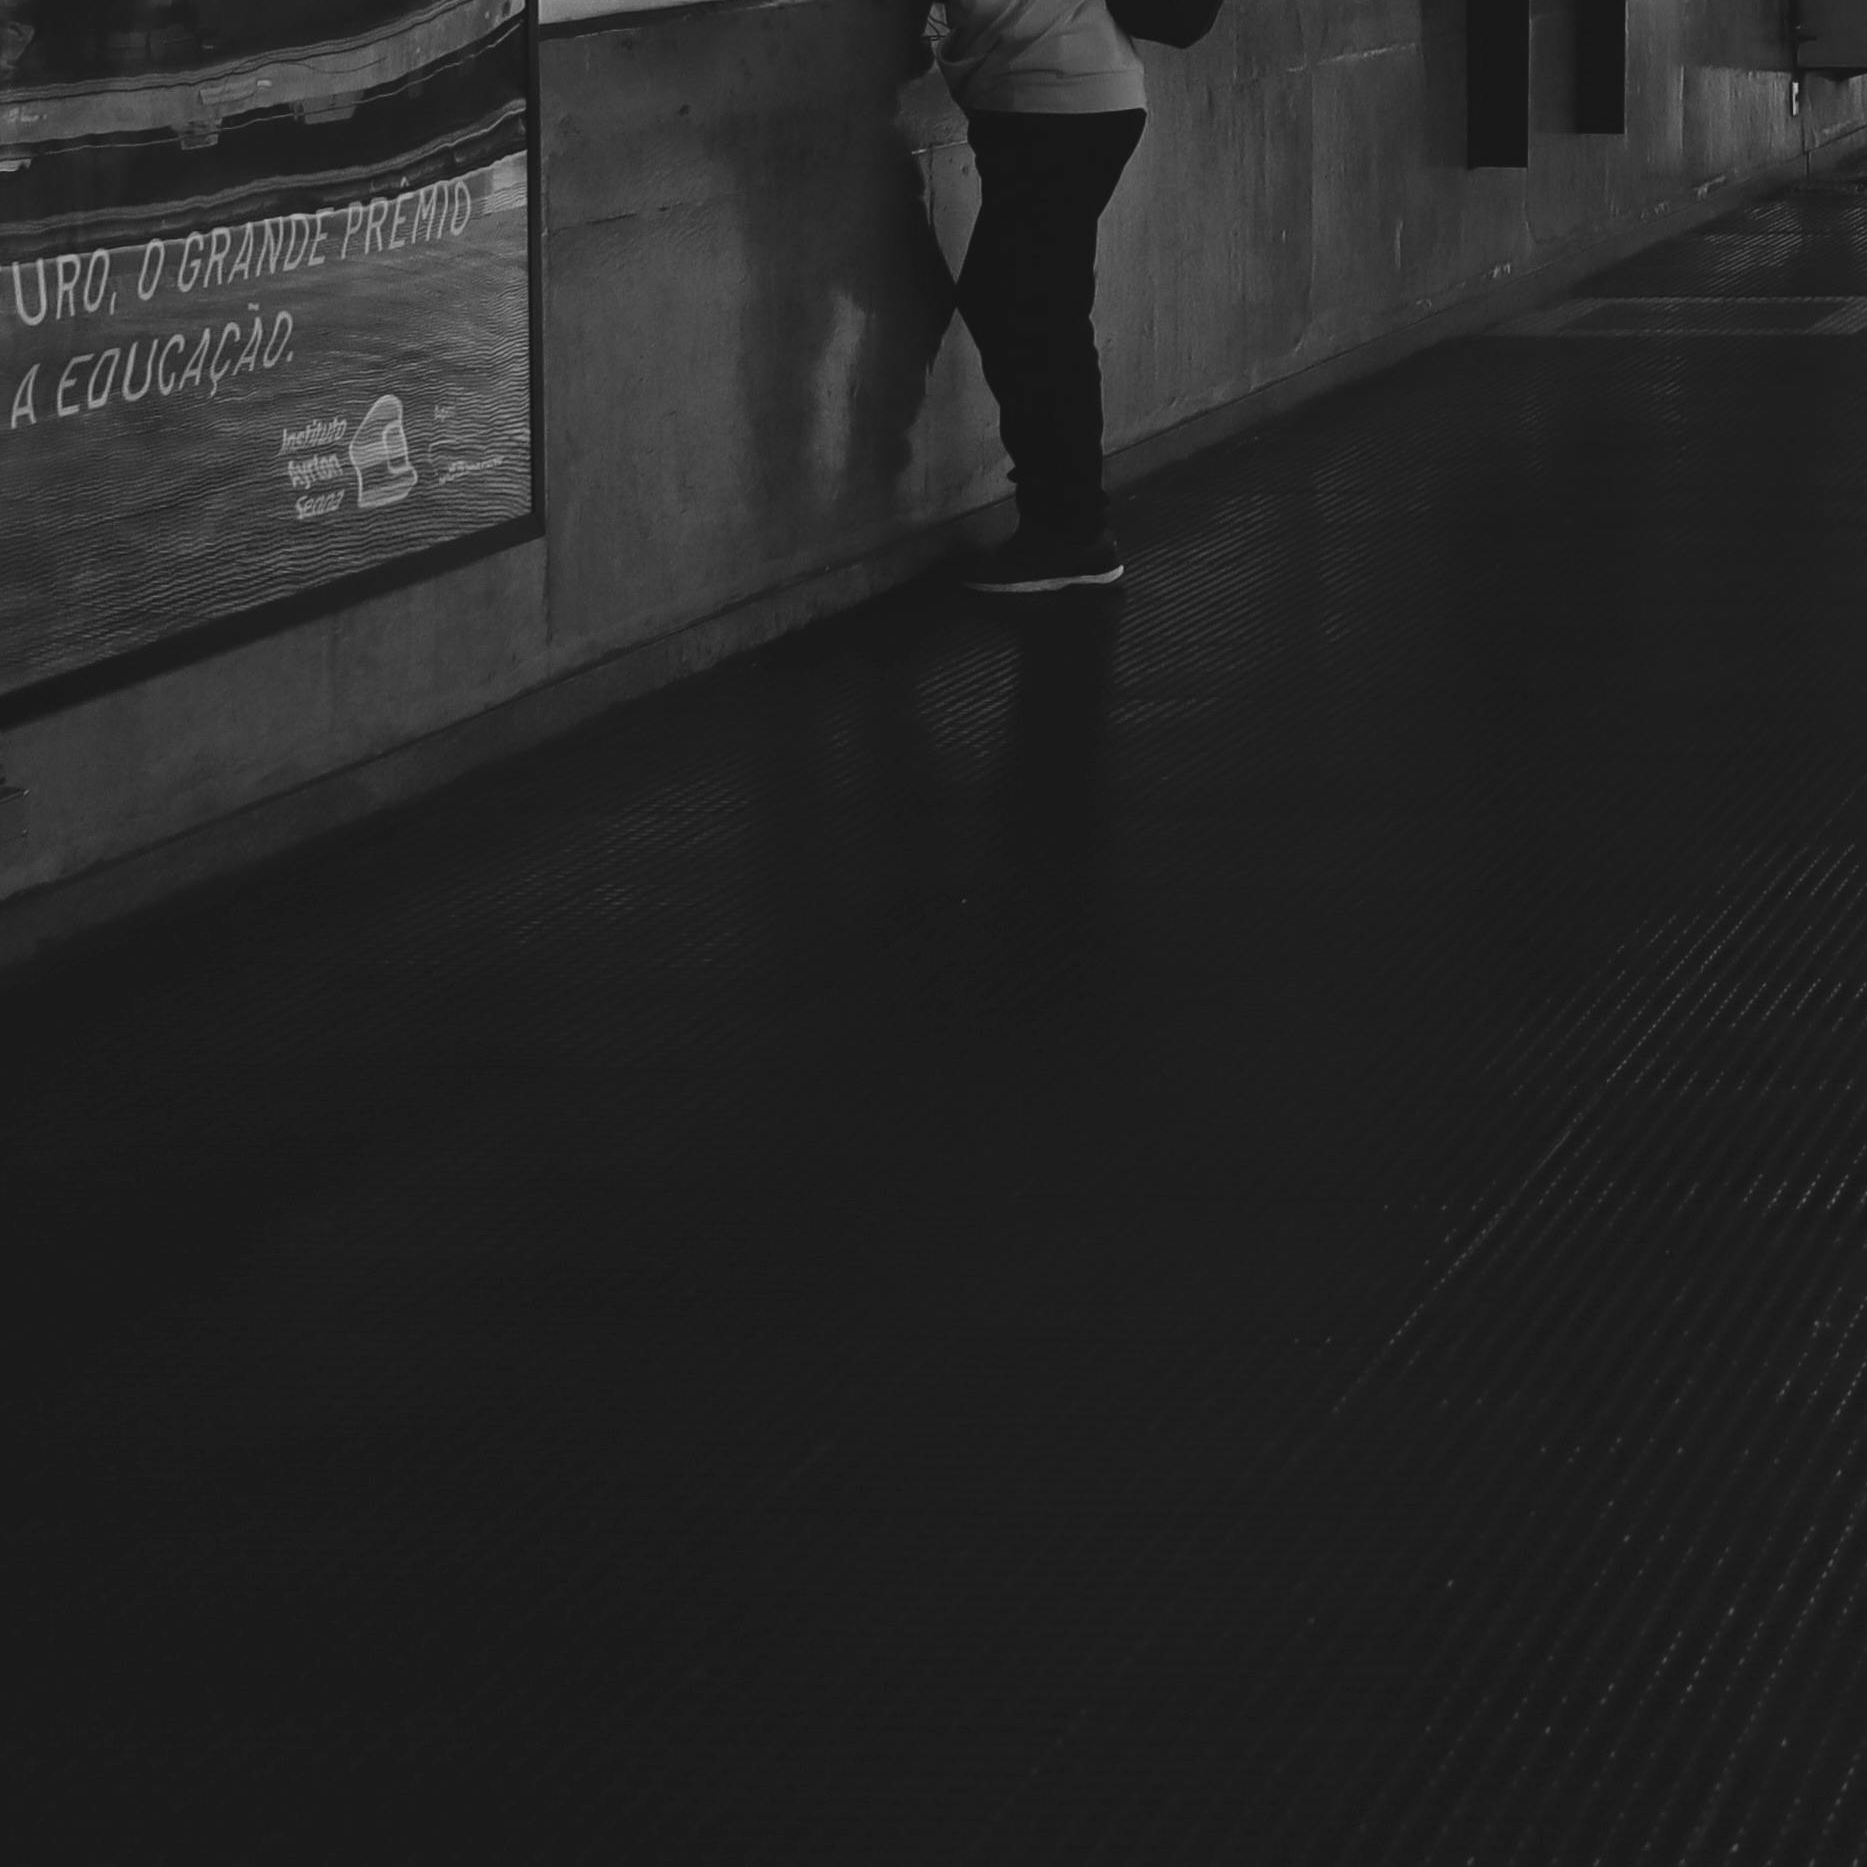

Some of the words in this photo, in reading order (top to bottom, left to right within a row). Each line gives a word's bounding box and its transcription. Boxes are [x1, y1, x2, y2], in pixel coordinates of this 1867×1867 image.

[11, 247, 117, 326] URO,
[137, 237, 166, 301] O
[176, 207, 335, 294] GRANDE
[341, 175, 473, 261] PRÊMIO
[56, 302, 296, 420] EDUCAÇÃO.
